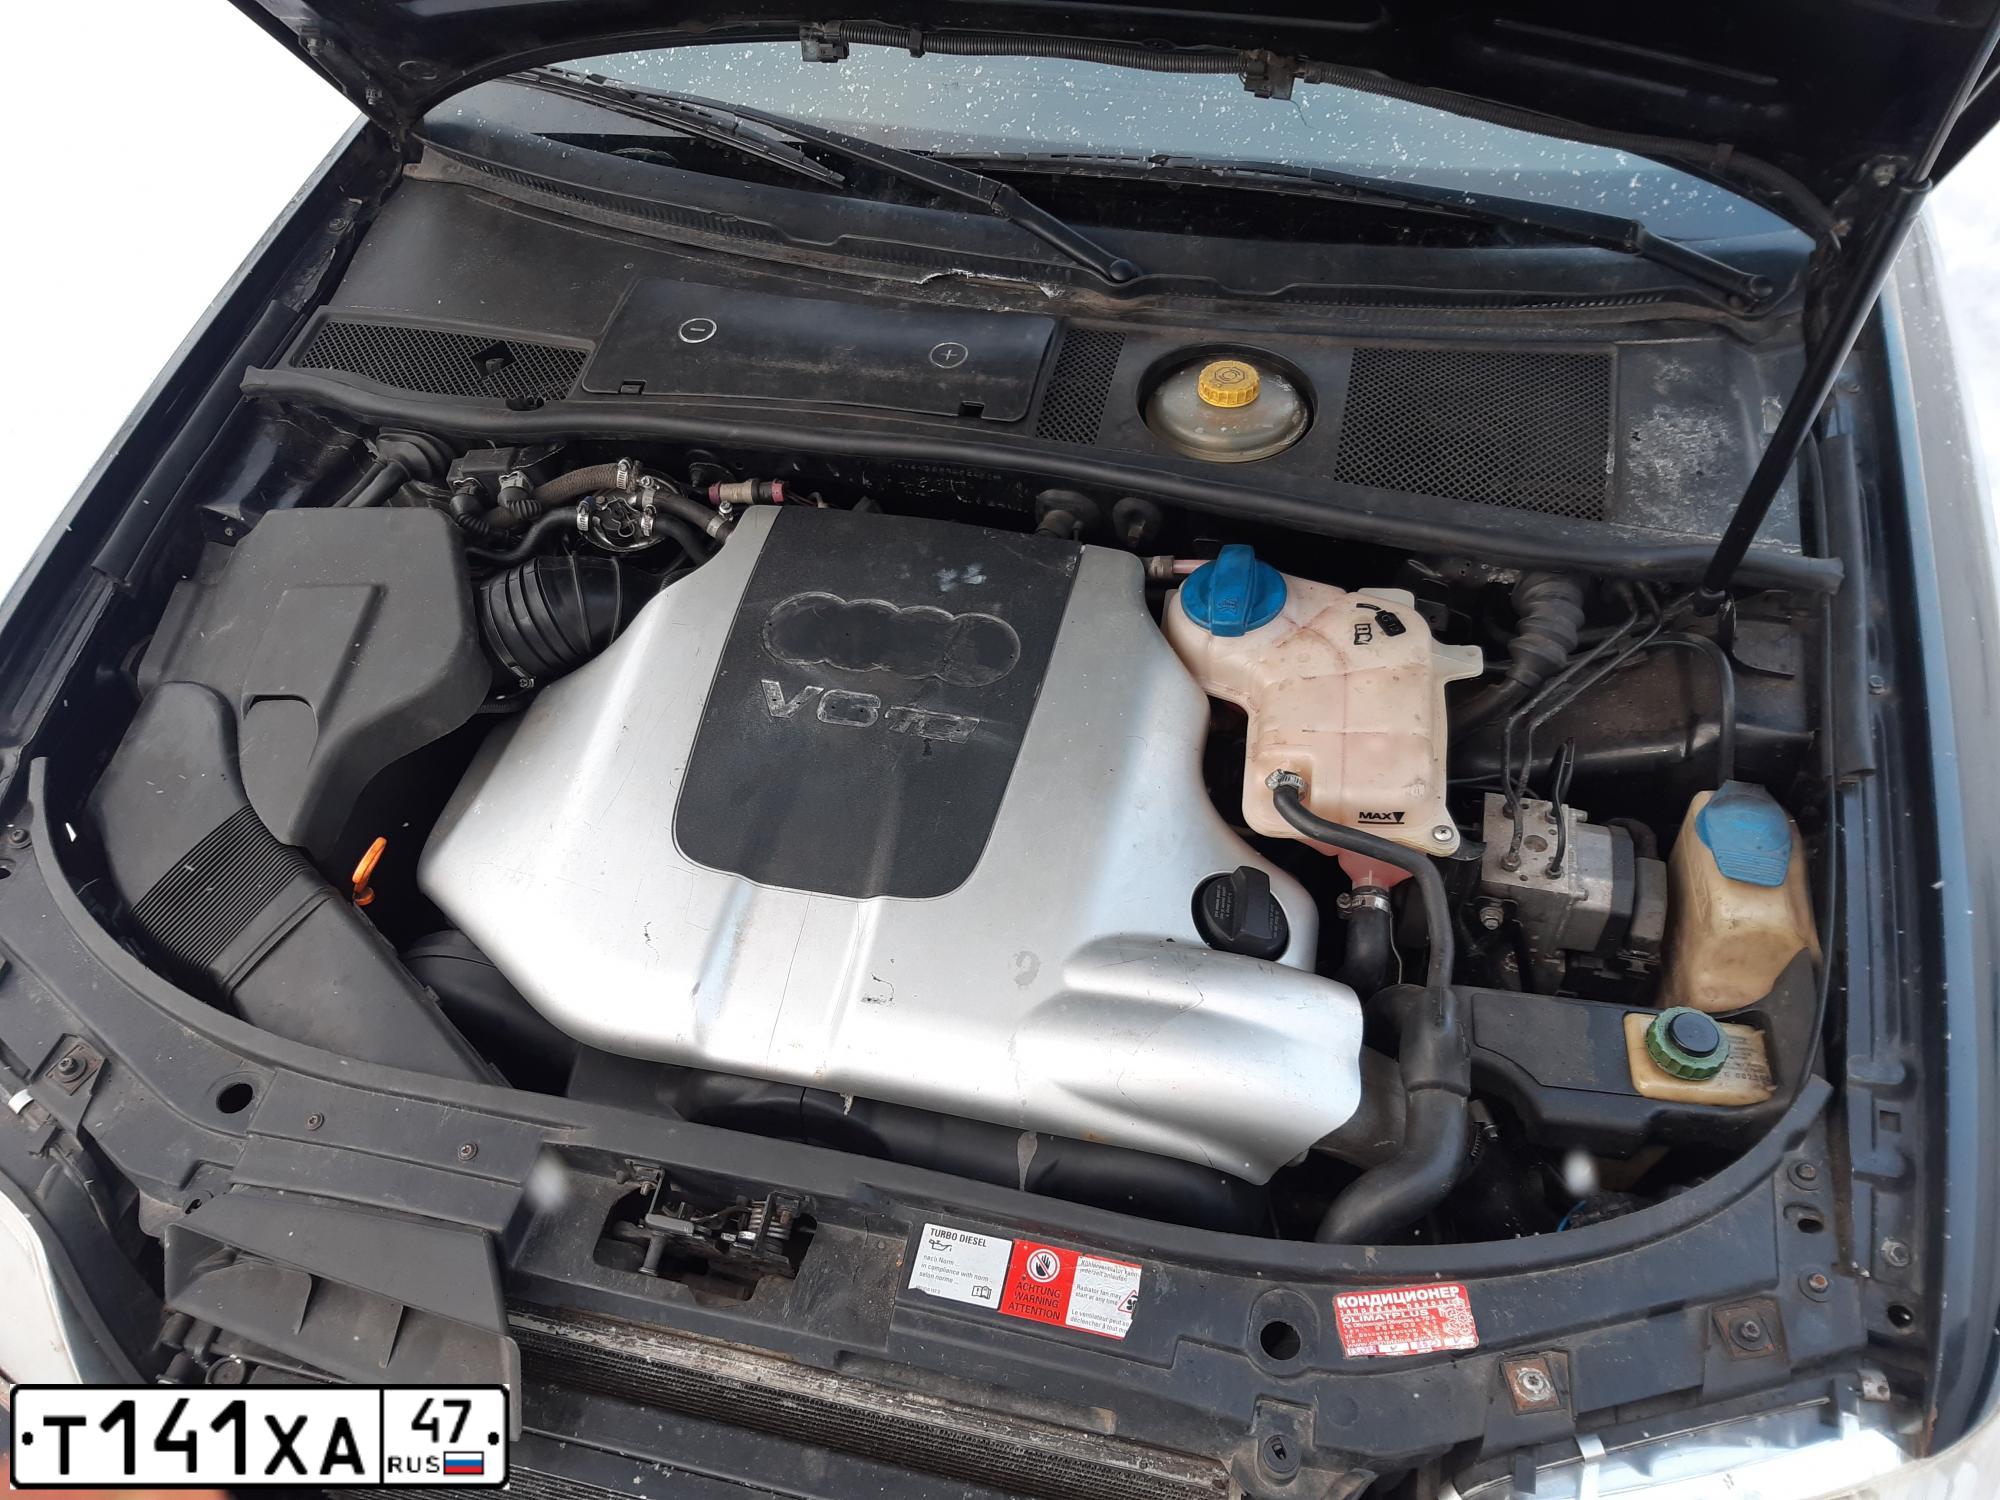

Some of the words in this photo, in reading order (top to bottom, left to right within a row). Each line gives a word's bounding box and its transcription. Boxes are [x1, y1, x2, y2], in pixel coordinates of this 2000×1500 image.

[761, 679, 881, 727] V6
[1359, 811, 1392, 820] MAX
[930, 1228, 958, 1241] TURBO
[959, 1234, 987, 1248] DIESEL
[919, 1271, 935, 1279] selon
[935, 1274, 953, 1283] norme
[928, 1264, 960, 1276] compliance
[960, 1270, 974, 1279] with
[1016, 1281, 1061, 1298] ACHTUNG
[1077, 1284, 1099, 1294] Radiator
[1337, 1286, 1460, 1308] КОНДИЦИОНЕР
[1014, 1291, 1060, 1309] WARNING
[1007, 1302, 1061, 1320] ATTENTION
